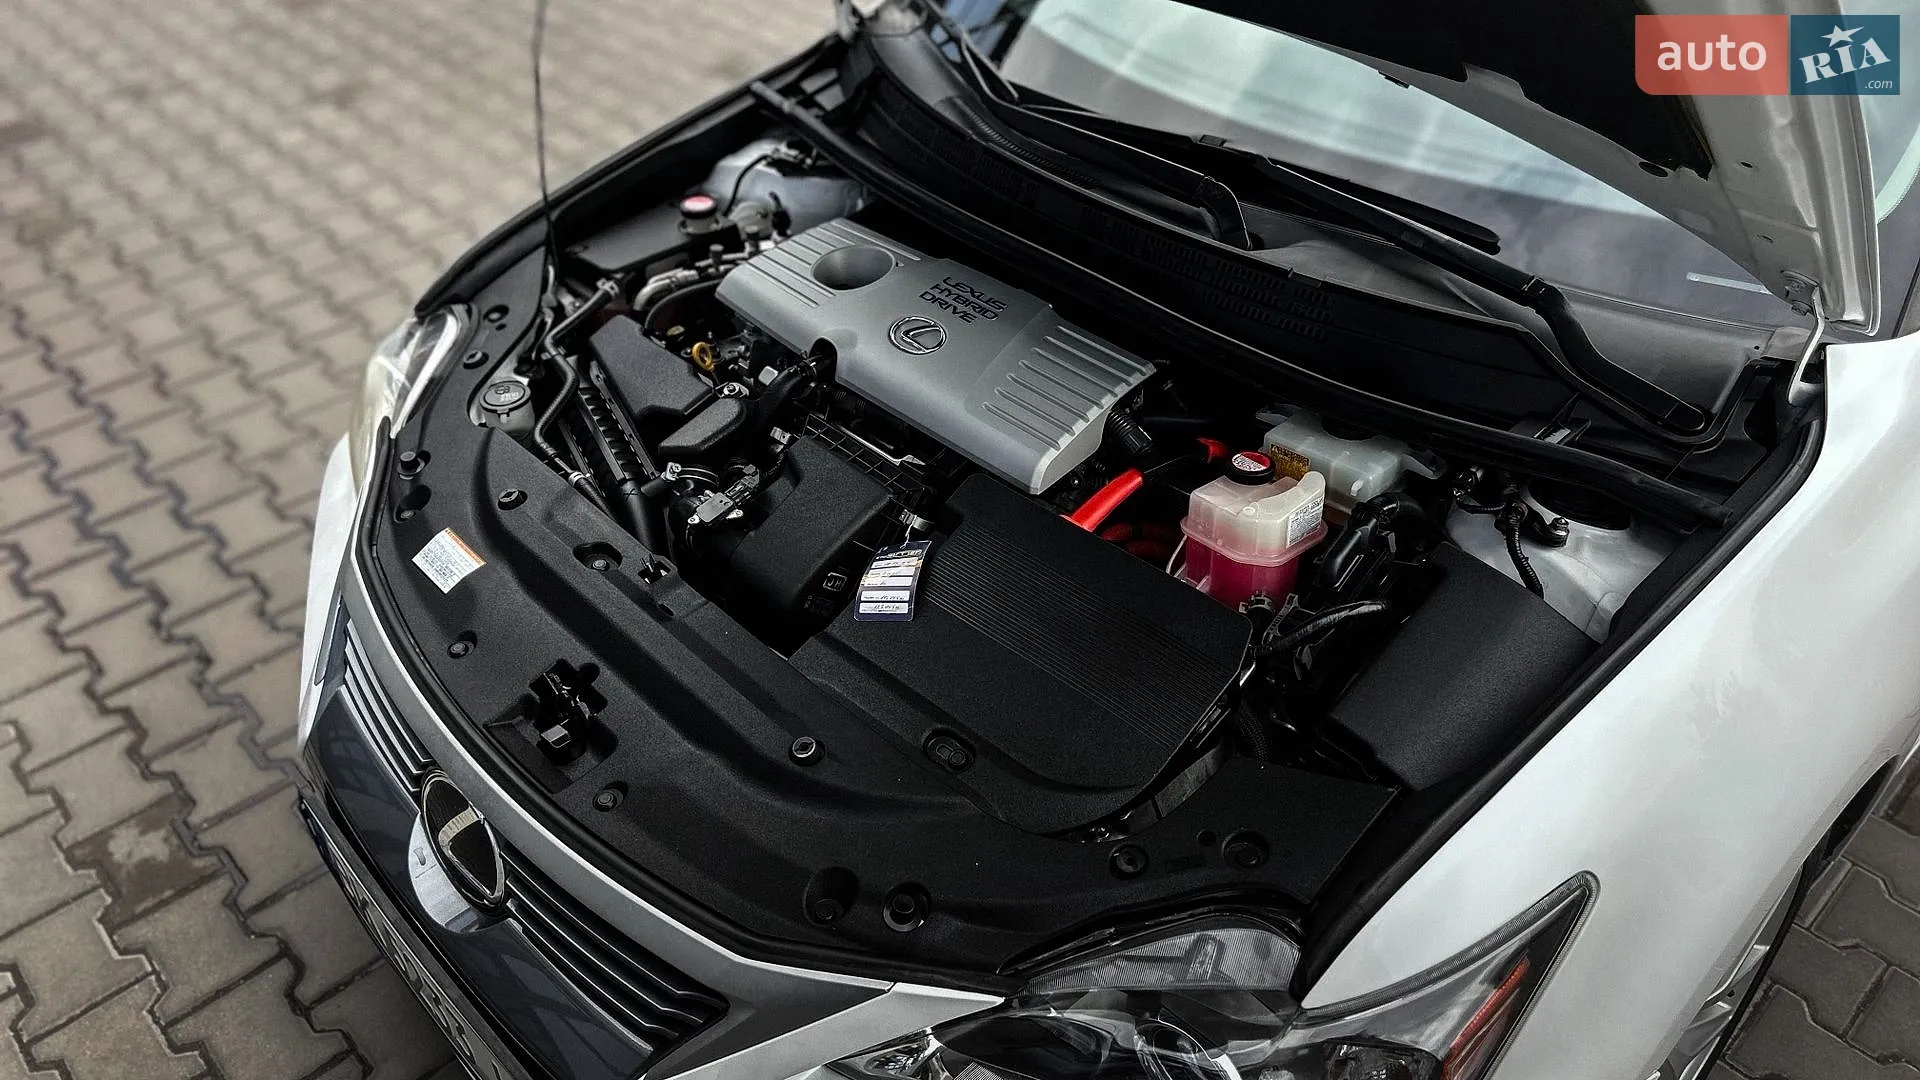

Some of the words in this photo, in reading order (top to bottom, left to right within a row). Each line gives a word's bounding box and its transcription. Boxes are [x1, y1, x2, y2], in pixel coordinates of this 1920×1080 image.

[919, 291, 978, 325] DRIVE
[930, 283, 999, 321] HYBRID
[942, 276, 1008, 312] LEXUS
